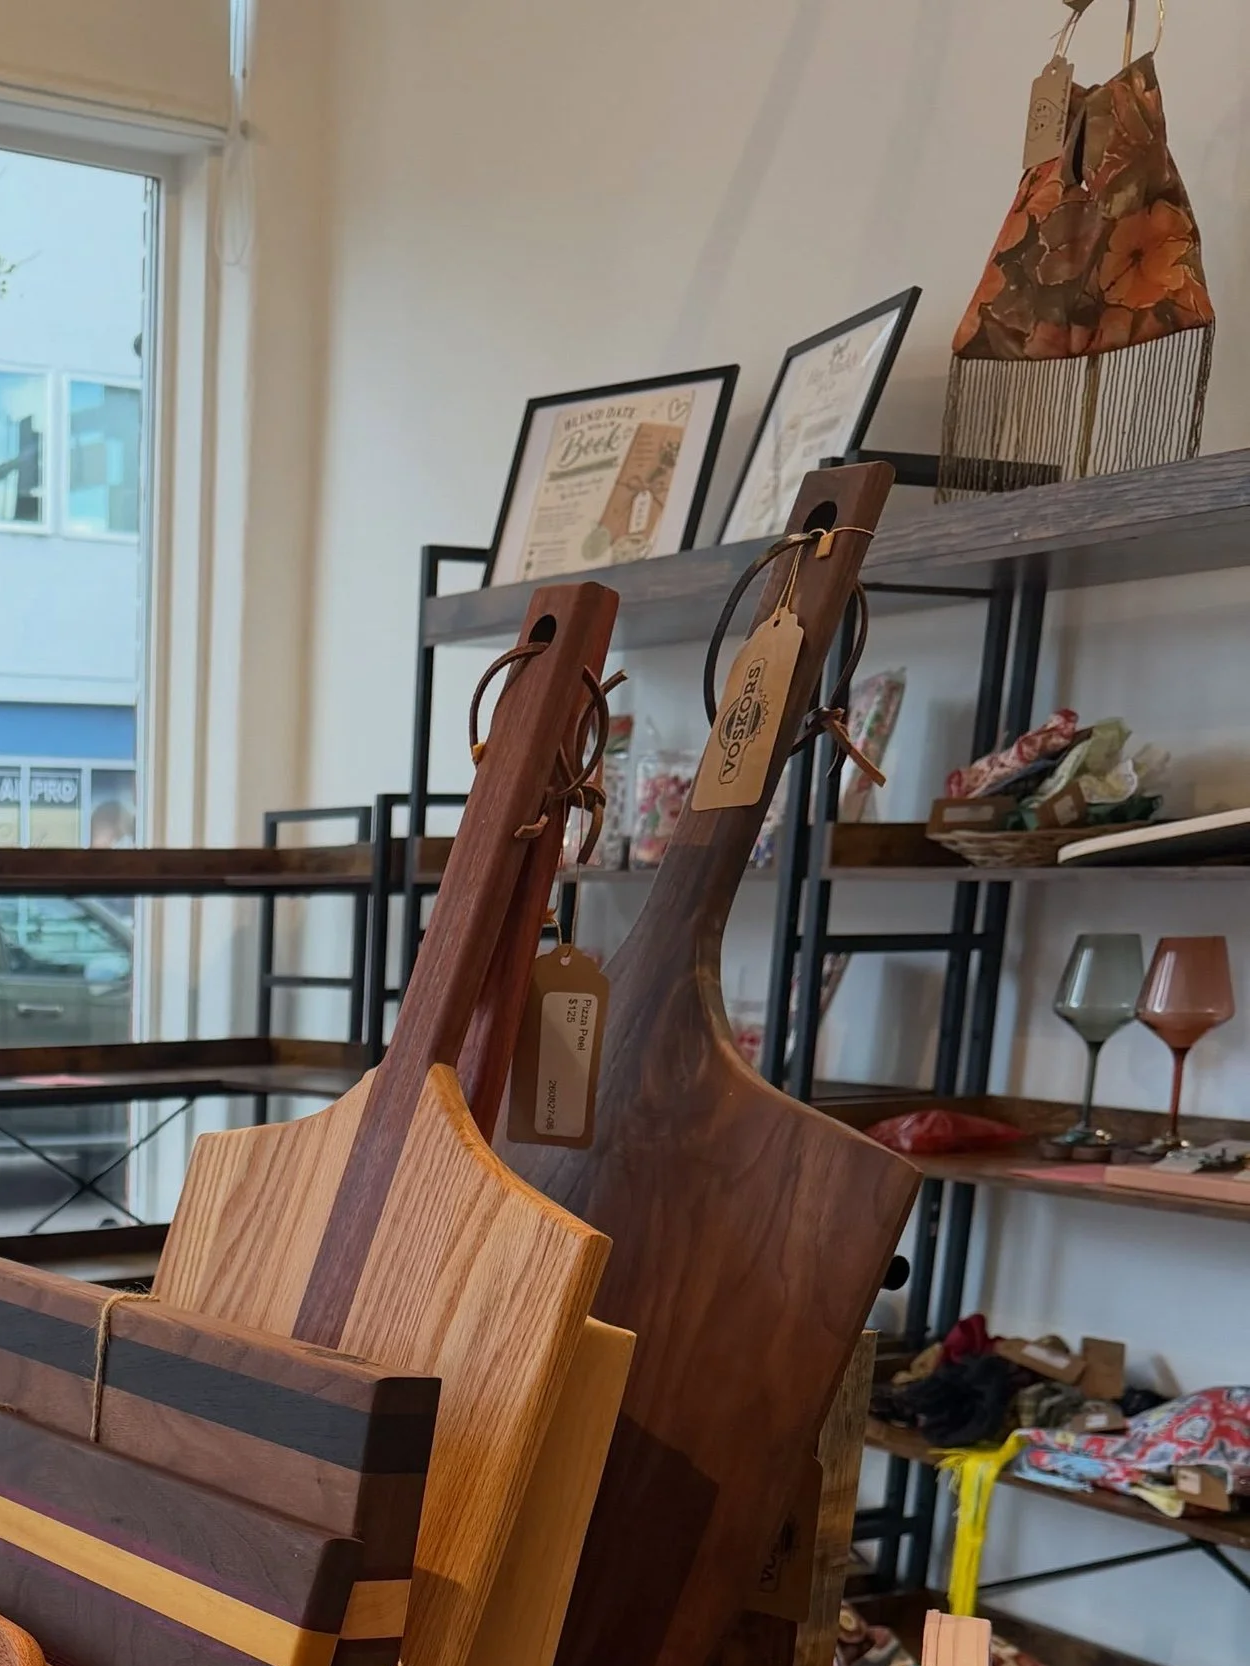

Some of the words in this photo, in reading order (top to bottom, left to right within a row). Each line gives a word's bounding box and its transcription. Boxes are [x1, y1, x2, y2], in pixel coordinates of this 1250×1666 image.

[722, 666, 761, 777] VOSKORS
[567, 999, 578, 1023] $125
[580, 1000, 592, 1026] Pizza
[577, 1029, 589, 1051] Peel
